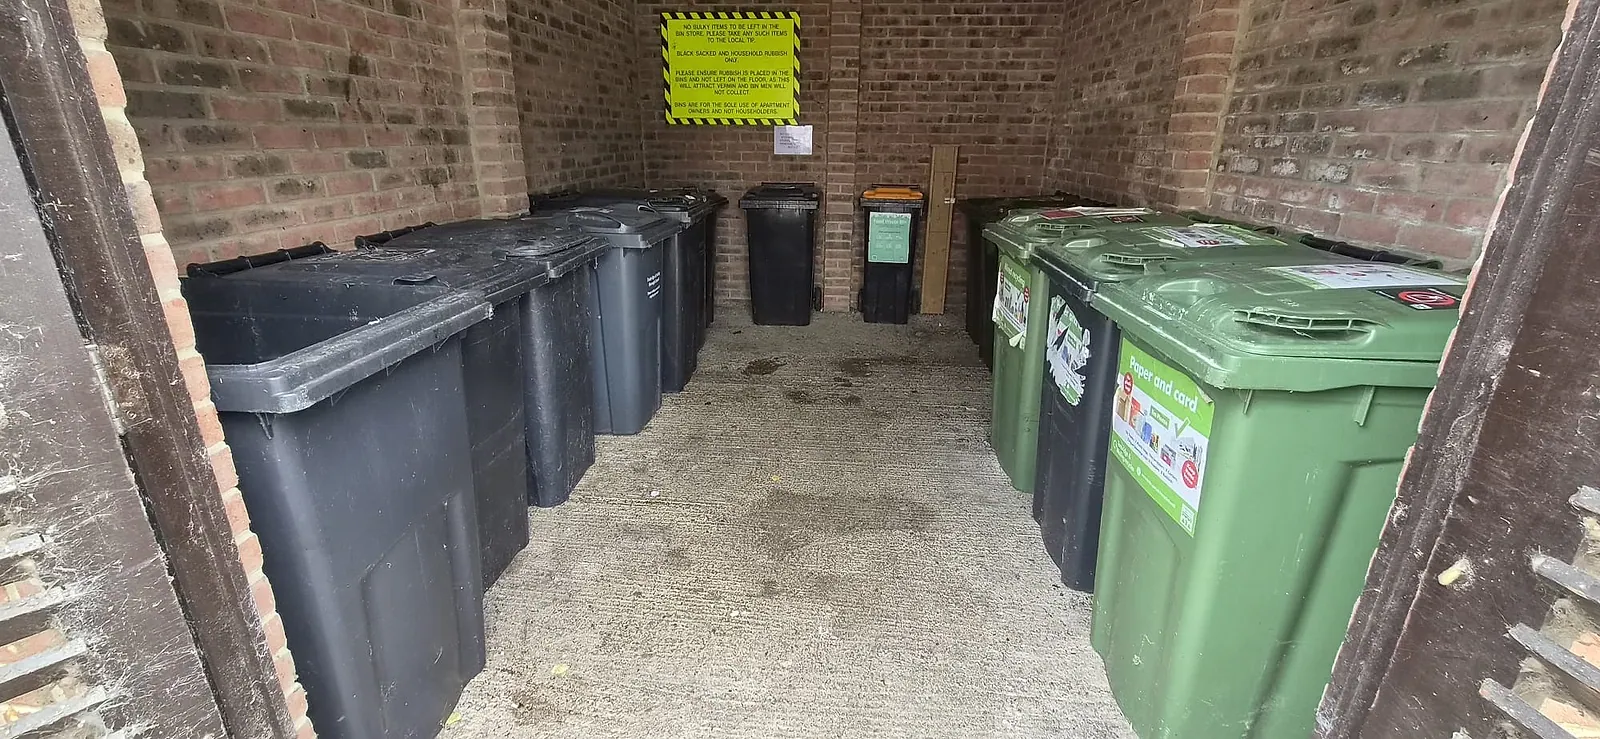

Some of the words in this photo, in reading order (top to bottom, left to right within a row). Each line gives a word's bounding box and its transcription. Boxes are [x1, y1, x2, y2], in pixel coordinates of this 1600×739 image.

[1129, 355, 1153, 382] Paper
[1153, 375, 1173, 397] and
[1173, 389, 1199, 414] card
